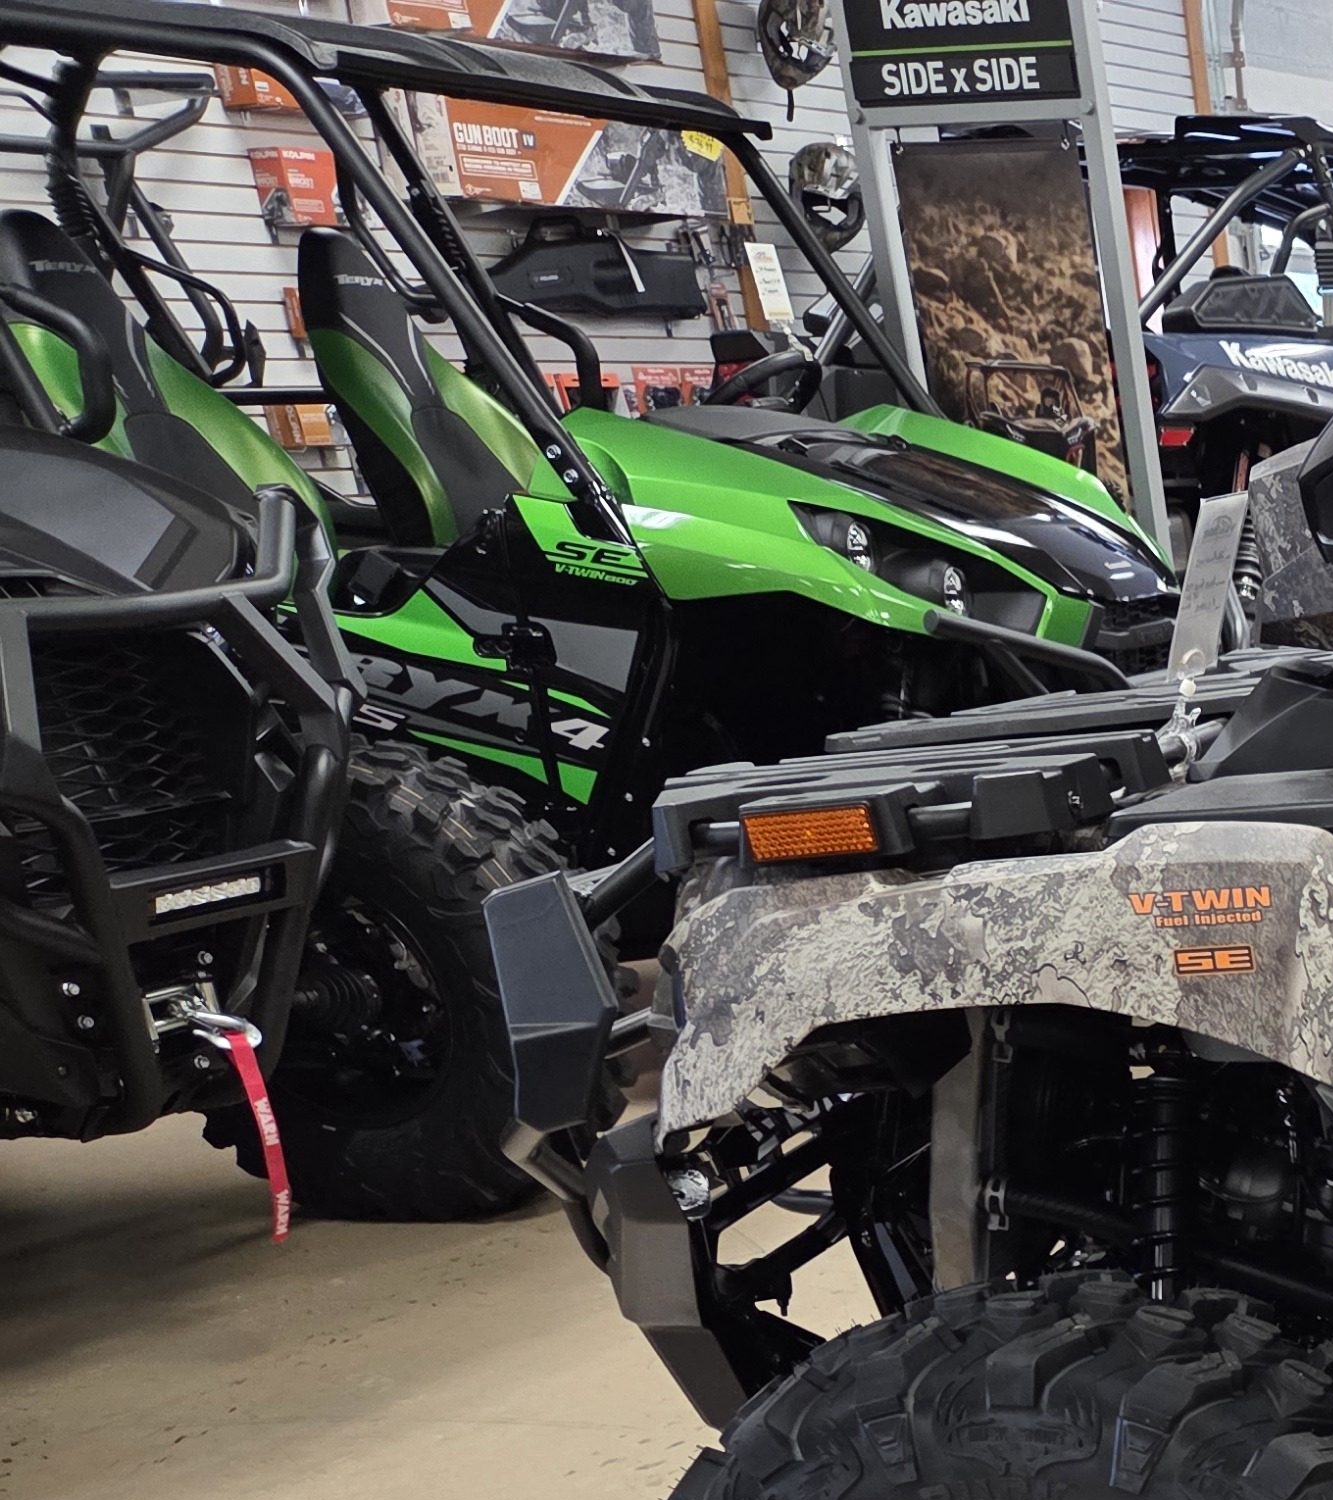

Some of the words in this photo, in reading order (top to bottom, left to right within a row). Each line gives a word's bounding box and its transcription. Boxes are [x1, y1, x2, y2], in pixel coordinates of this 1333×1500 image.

[880, 0, 1031, 30] Kawasaki
[881, 61, 948, 96] SIDE
[950, 68, 971, 93] x
[973, 57, 1041, 92] SIDE
[453, 122, 482, 146] GUN
[483, 124, 519, 150] BOOT
[285, 405, 302, 443] OLPIN
[550, 541, 640, 571] SE
[1128, 886, 1272, 915] V-TWIN
[1156, 915, 1189, 928] Fuel
[1194, 910, 1263, 926] Injected
[1176, 949, 1252, 972] SE
[254, 1097, 280, 1147] WARN
[275, 1188, 290, 1236] WARN
